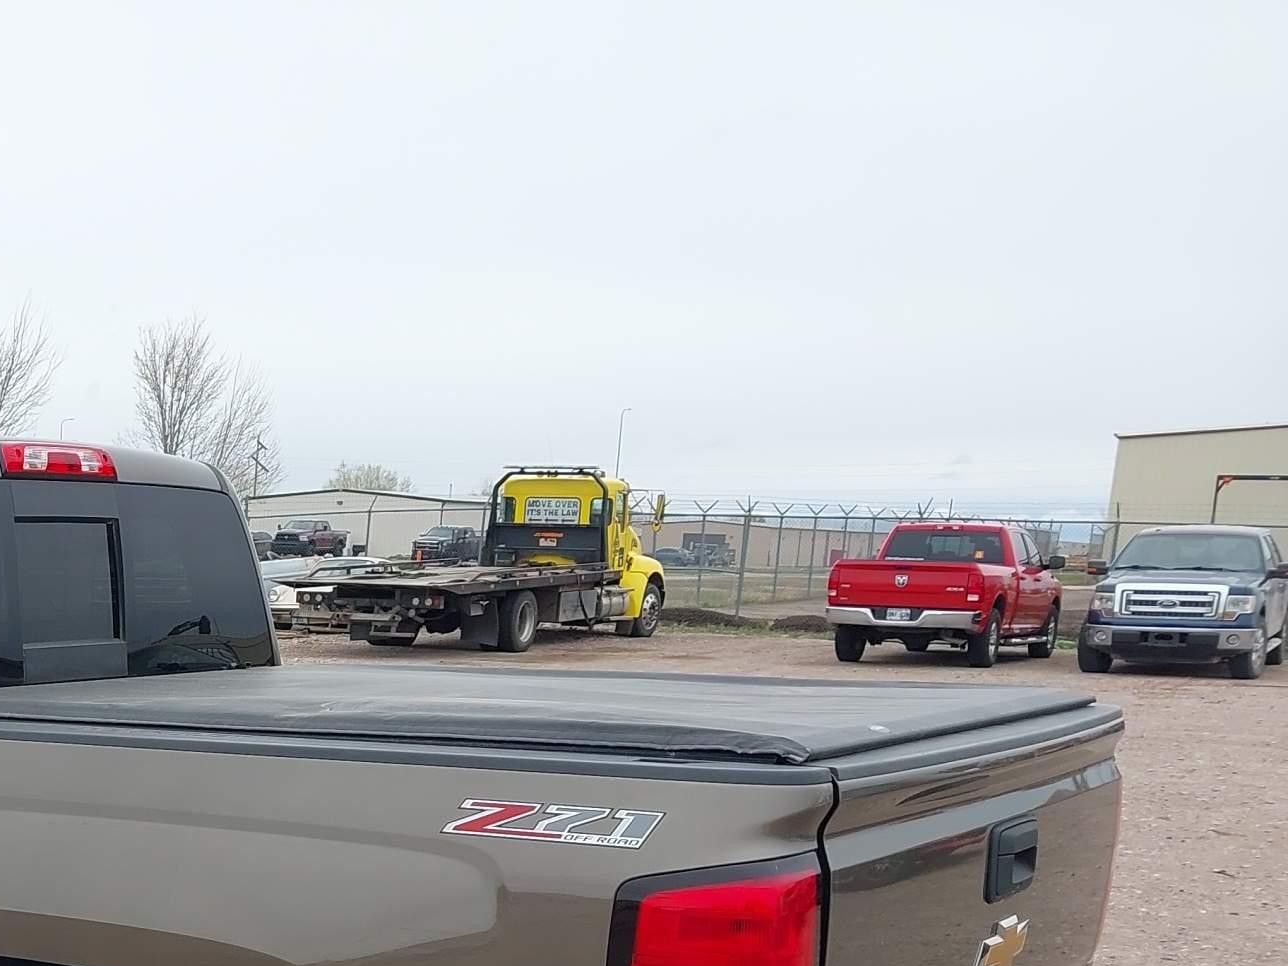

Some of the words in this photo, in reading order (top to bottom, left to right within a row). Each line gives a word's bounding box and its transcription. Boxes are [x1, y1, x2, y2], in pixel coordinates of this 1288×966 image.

[528, 500, 553, 508] MOVE
[555, 500, 578, 508] OVER
[440, 798, 667, 847] Z71
[563, 834, 594, 843] OFF
[596, 836, 640, 847] ROAD
